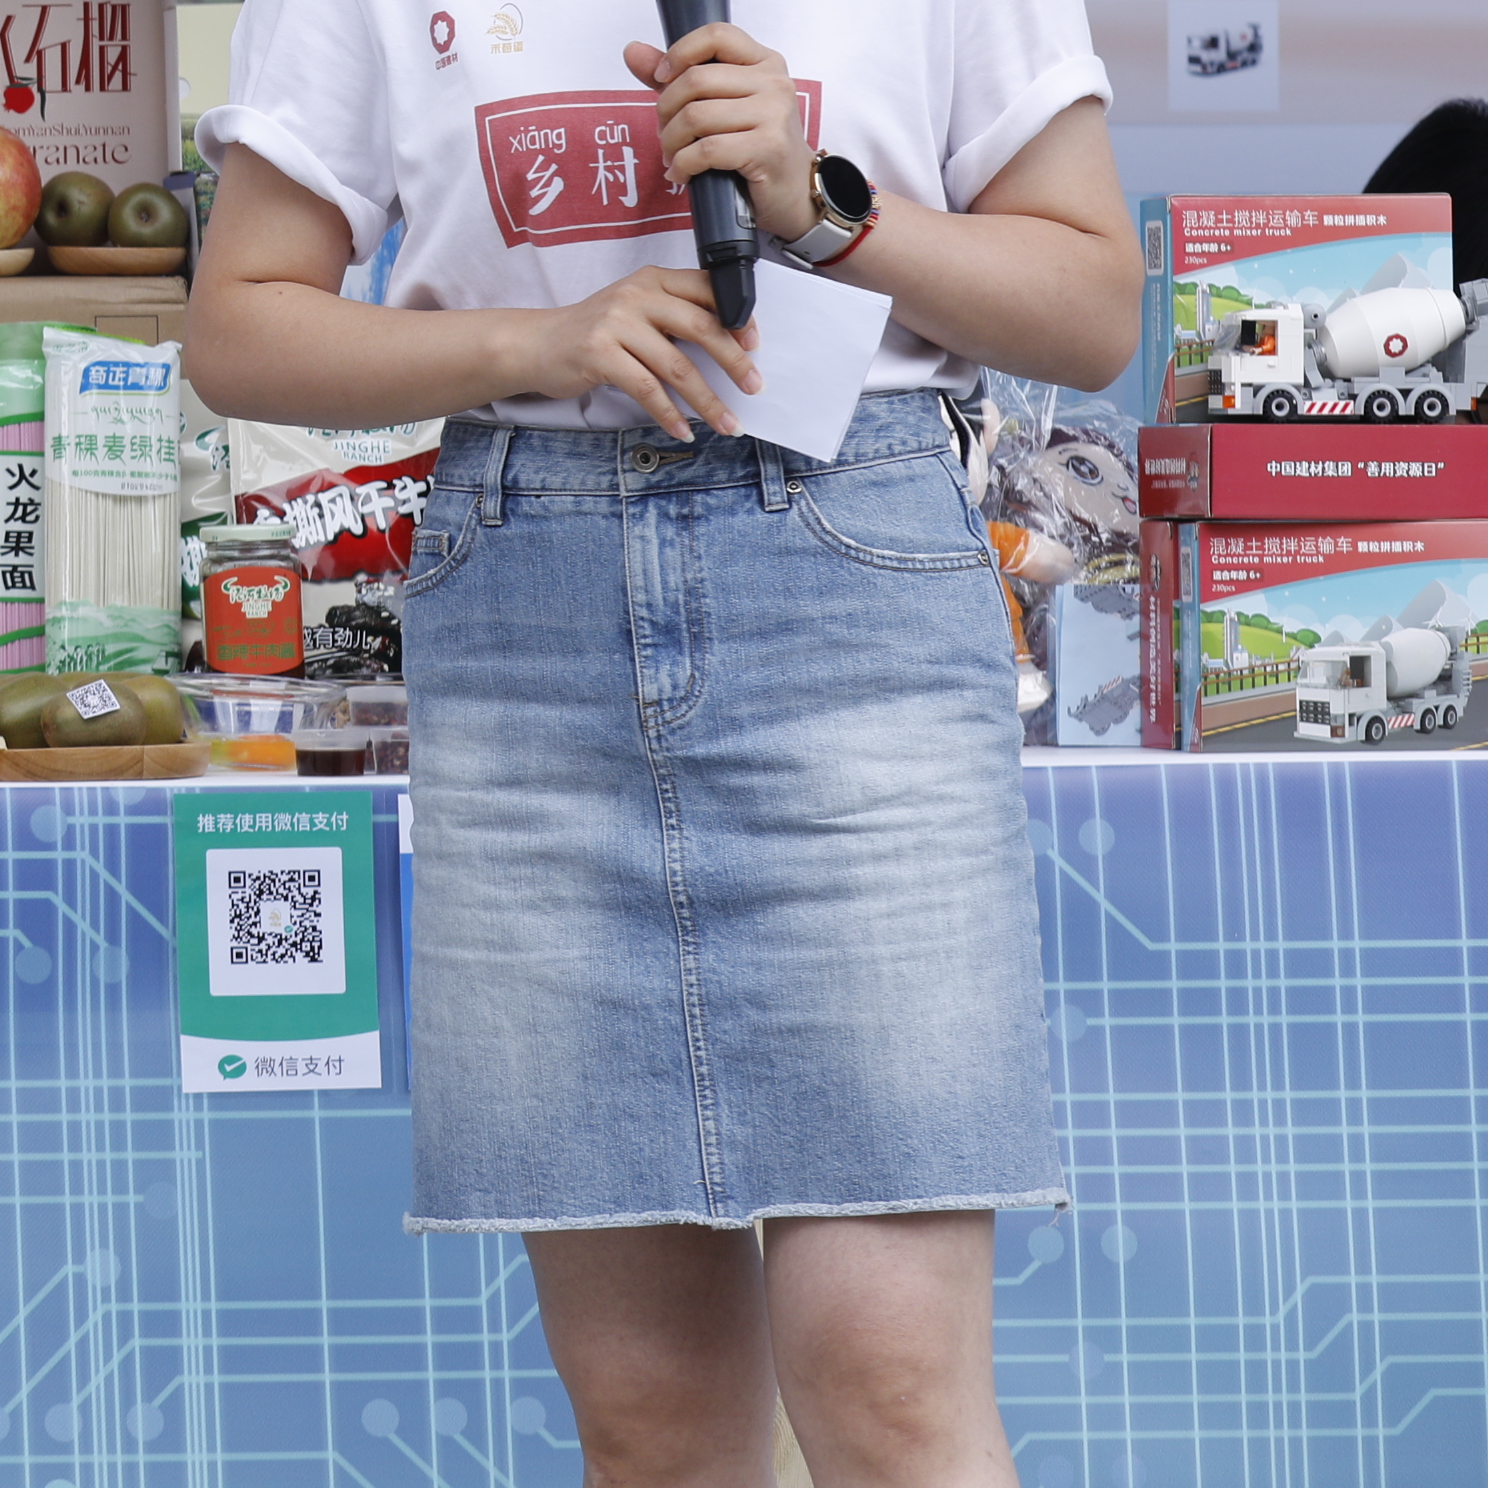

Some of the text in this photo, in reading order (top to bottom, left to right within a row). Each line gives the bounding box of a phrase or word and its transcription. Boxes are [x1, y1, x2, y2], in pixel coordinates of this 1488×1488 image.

[509, 120, 630, 153] xiāng cūn
[29, 141, 132, 165] ranate
[1182, 210, 1319, 228] 混凝土搅拌运输车
[1184, 227, 1292, 237] Concrete mixer truck
[50, 432, 181, 468] 青稞麦绿挂
[334, 441, 391, 454] JINGHE
[343, 451, 383, 463] RANCH
[254, 475, 435, 549] 撕风干牛
[0, 463, 43, 592] 火龙果面
[1209, 537, 1353, 554] 混凝土搅拌运输车
[1212, 554, 1324, 564] Concrete mixer truck
[1249, 570, 1261, 580] 6+
[1212, 583, 1236, 593] 230pcs
[197, 811, 349, 833] 推荐使用微信支付
[254, 1055, 345, 1078] 微信支付
